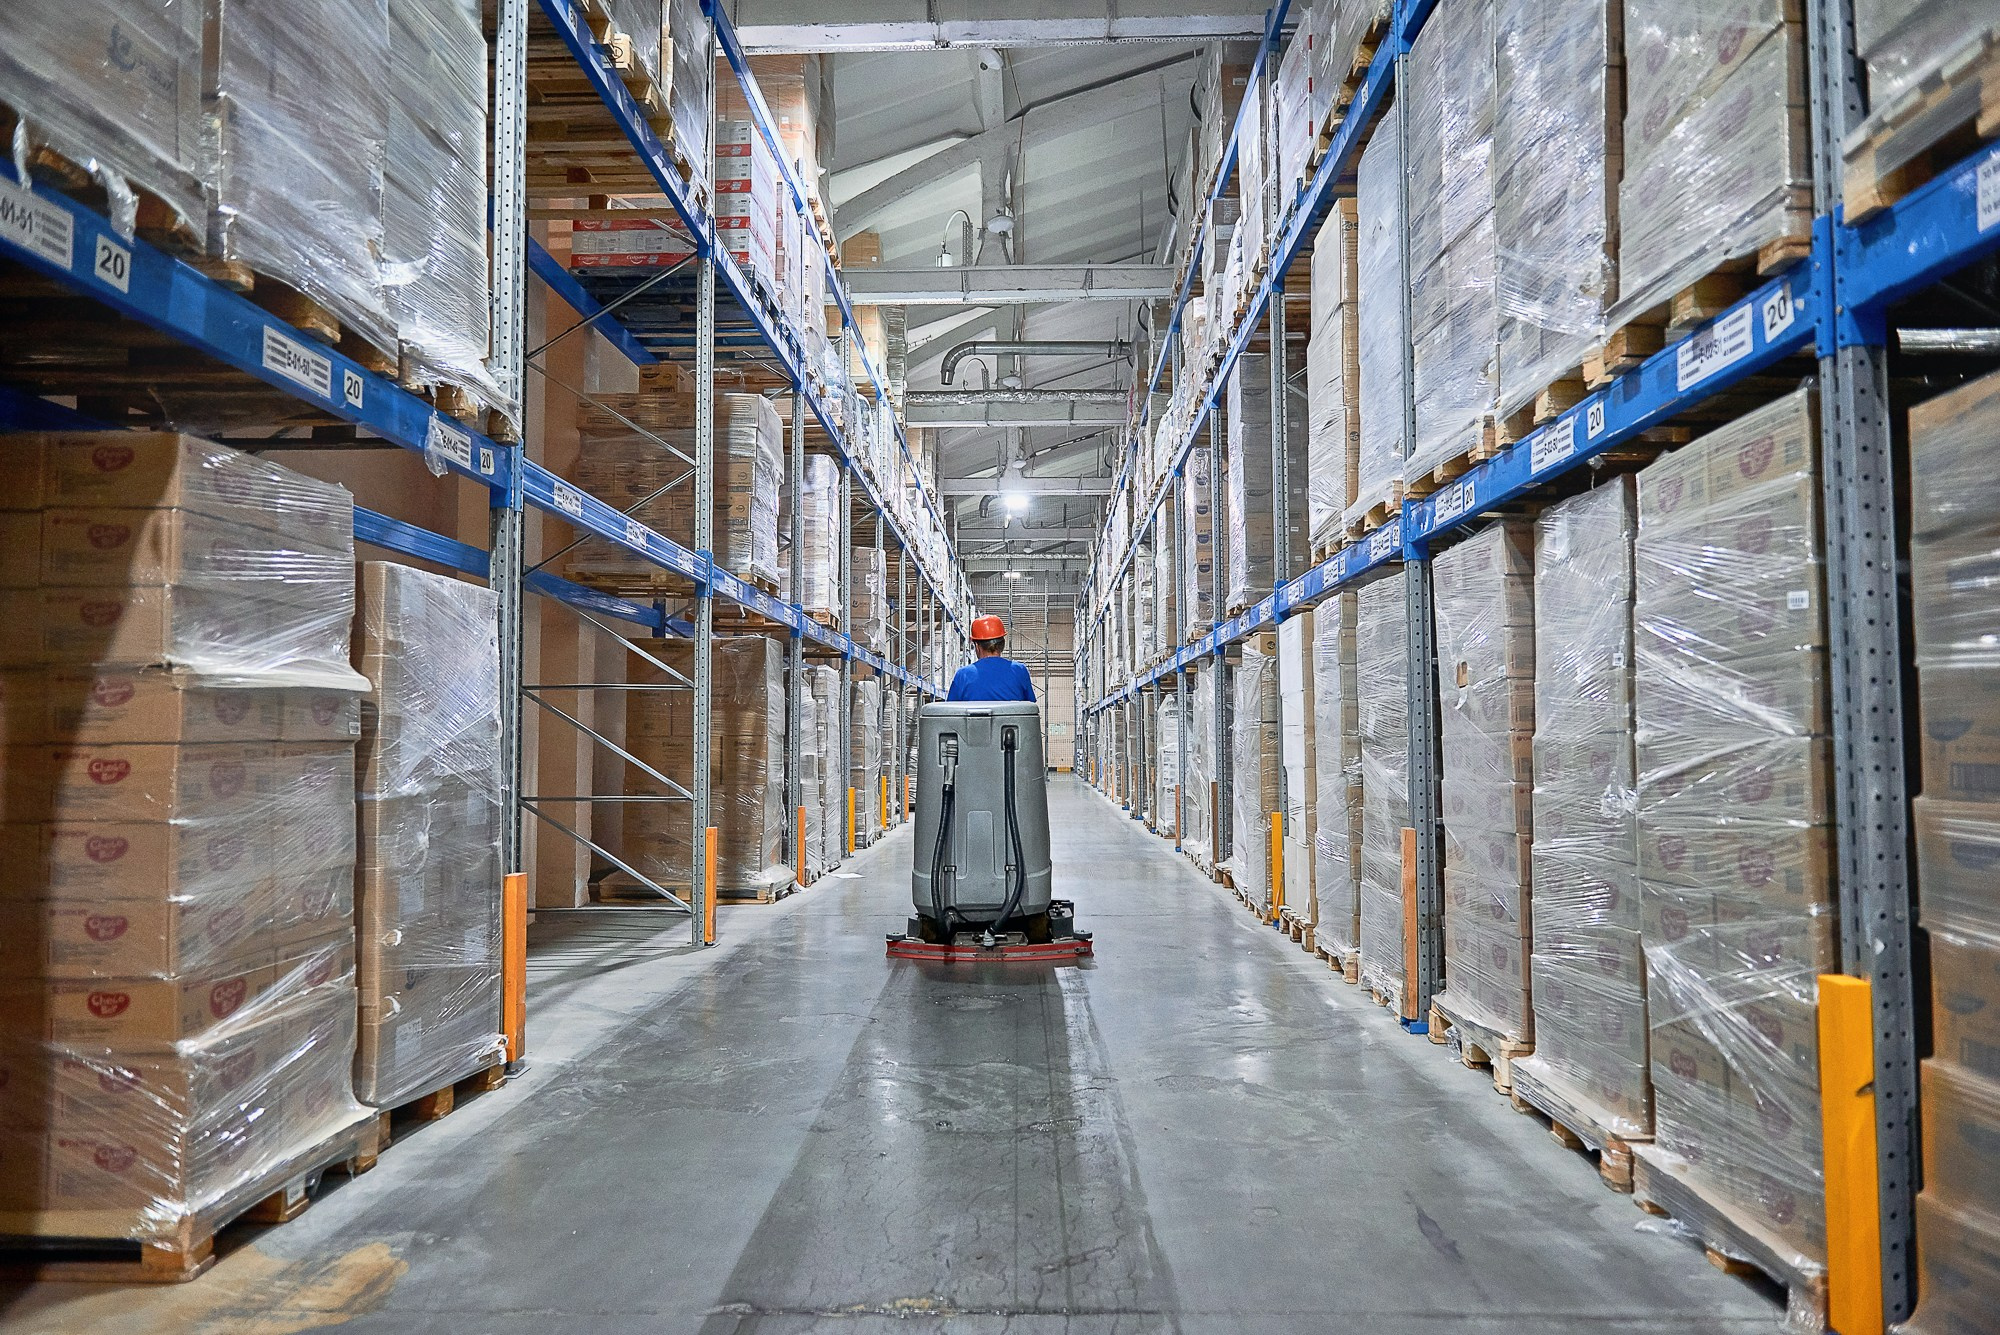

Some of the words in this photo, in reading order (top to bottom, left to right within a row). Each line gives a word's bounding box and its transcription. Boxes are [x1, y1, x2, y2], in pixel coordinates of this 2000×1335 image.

[101, 245, 125, 280] 20
[627, 254, 647, 262] Colgate
[1767, 296, 1787, 331] 20
[346, 376, 361, 399] 20
[1589, 408, 1602, 431] 20
[481, 452, 491, 469] 20
[92, 762, 127, 773] Choco
[92, 994, 126, 1006] Choco
